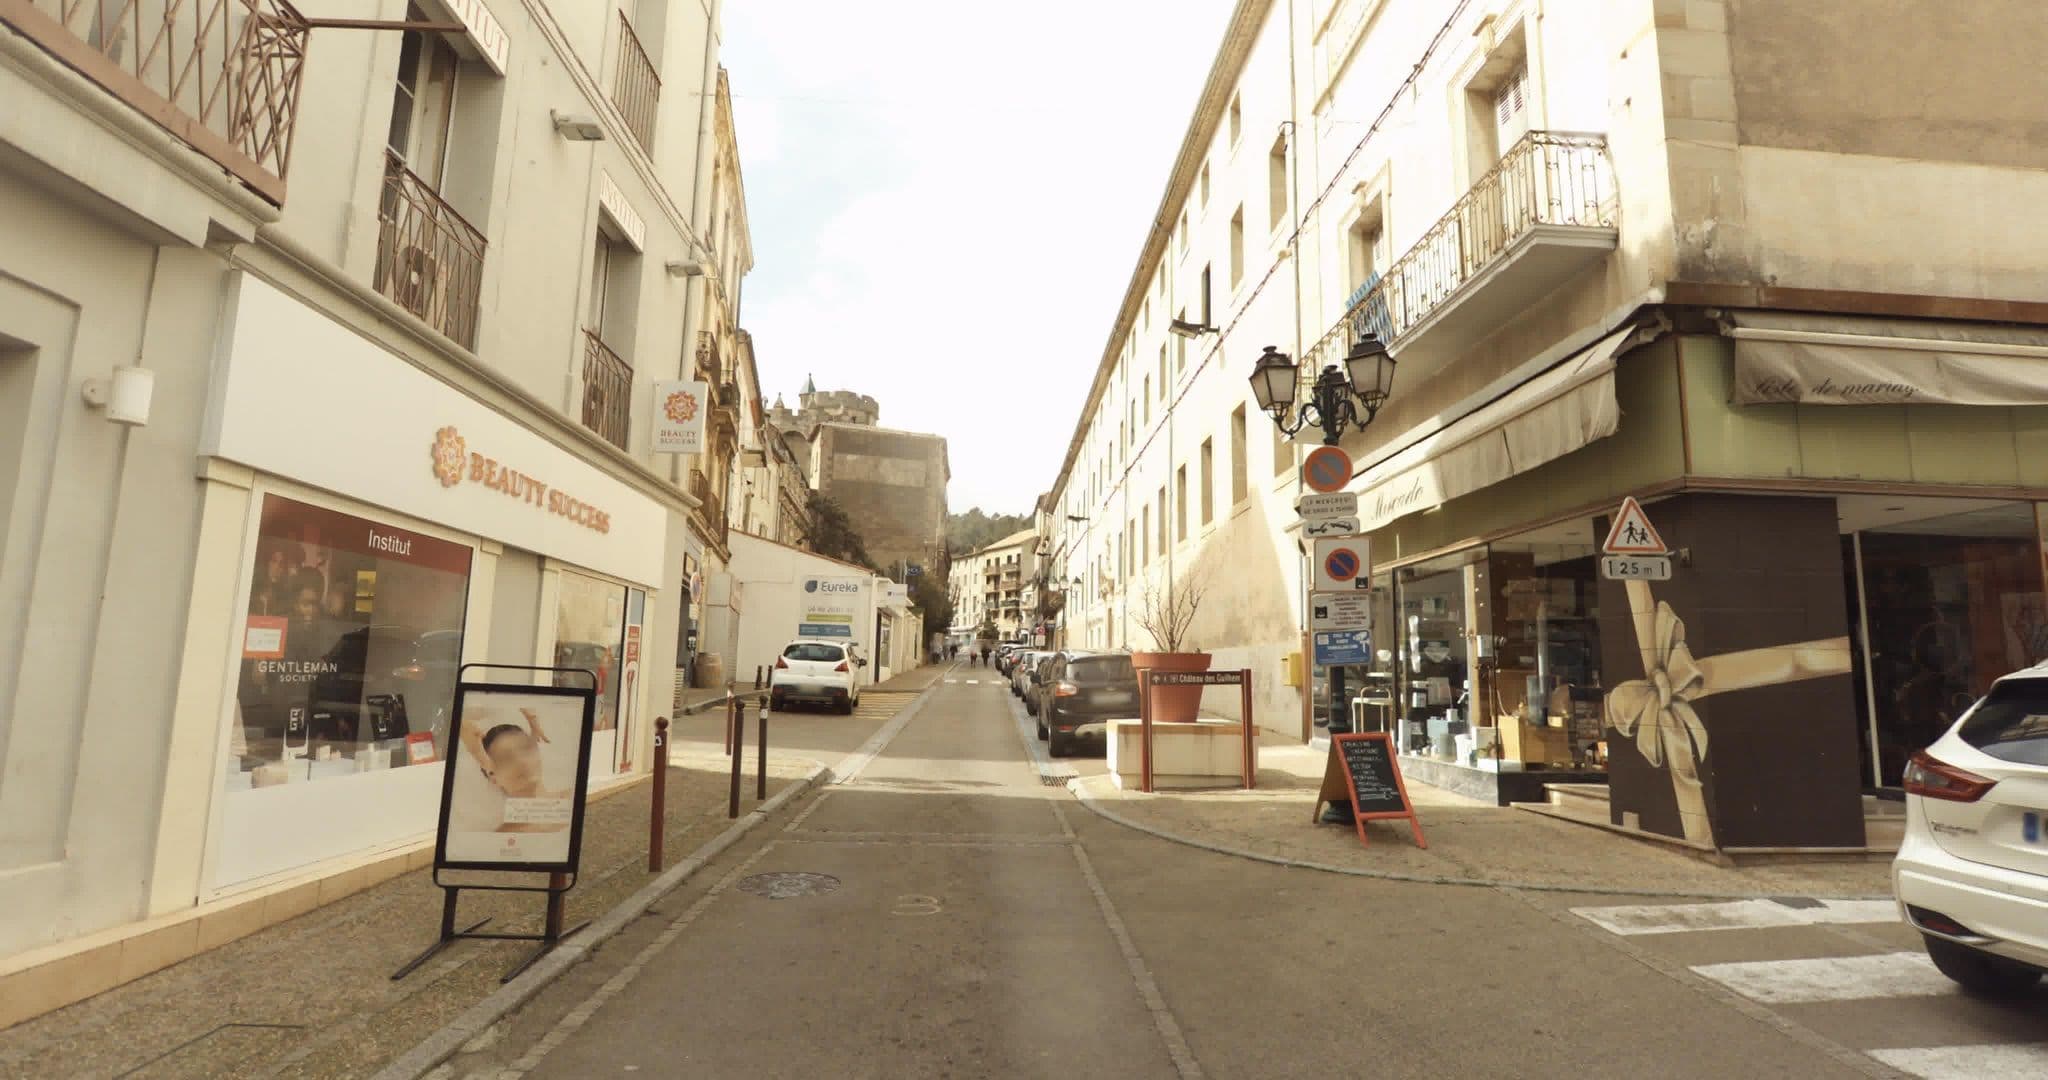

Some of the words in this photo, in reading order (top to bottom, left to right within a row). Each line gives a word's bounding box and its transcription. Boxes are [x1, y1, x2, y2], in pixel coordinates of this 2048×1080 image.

[660, 429, 697, 437] BEAUTY
[470, 451, 547, 507] BEAUTY
[548, 488, 611, 534] SUCCESS
[368, 529, 411, 556] Institut
[821, 581, 859, 593] Eureka
[258, 660, 338, 673] GENTLEMAN
[279, 674, 319, 682] SOCIETY
